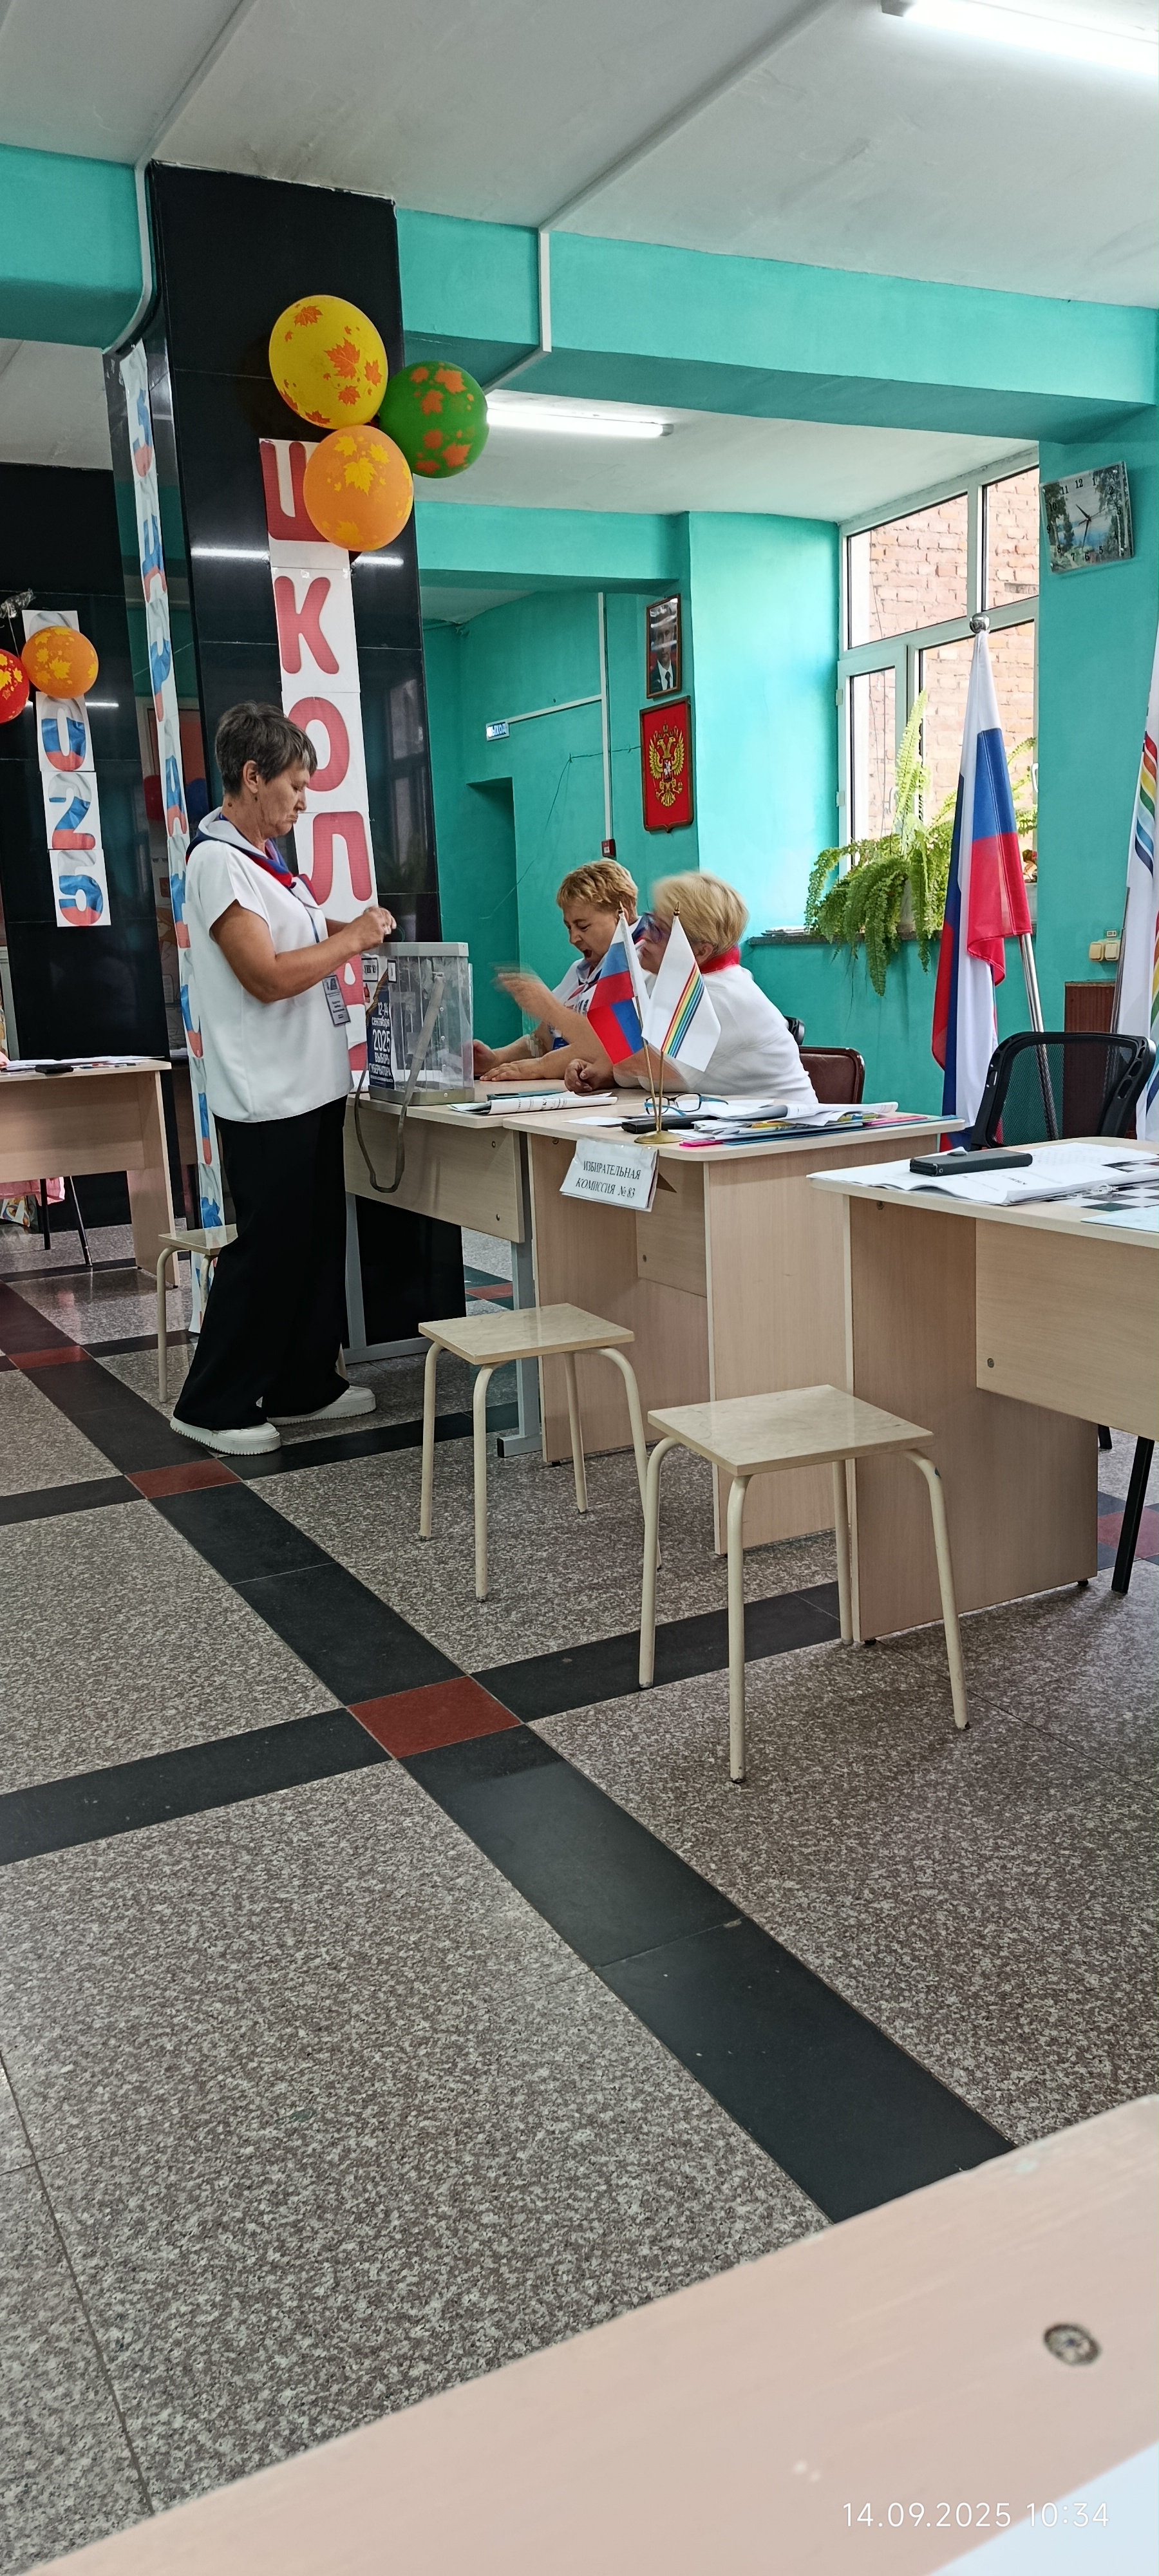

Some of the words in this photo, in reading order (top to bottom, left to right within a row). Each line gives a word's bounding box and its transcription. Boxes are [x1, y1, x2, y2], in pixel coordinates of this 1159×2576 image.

[1075, 478, 1084, 489] 12
[1061, 486, 1069, 495] 11
[1109, 486, 1114, 495] 2
[1049, 502, 1057, 512] 10
[1117, 506, 1122, 515] 3
[1098, 545, 1103, 554] 5
[1070, 552, 1075, 562] 7
[1084, 552, 1089, 562] 6
[487, 723, 506, 737] ЫХОД
[373, 1029, 391, 1052] 2025
[583, 1160, 641, 1180] ИЗБИРАТЕЛЬНАЯ
[576, 1177, 616, 1195] КОМИССИЯ
